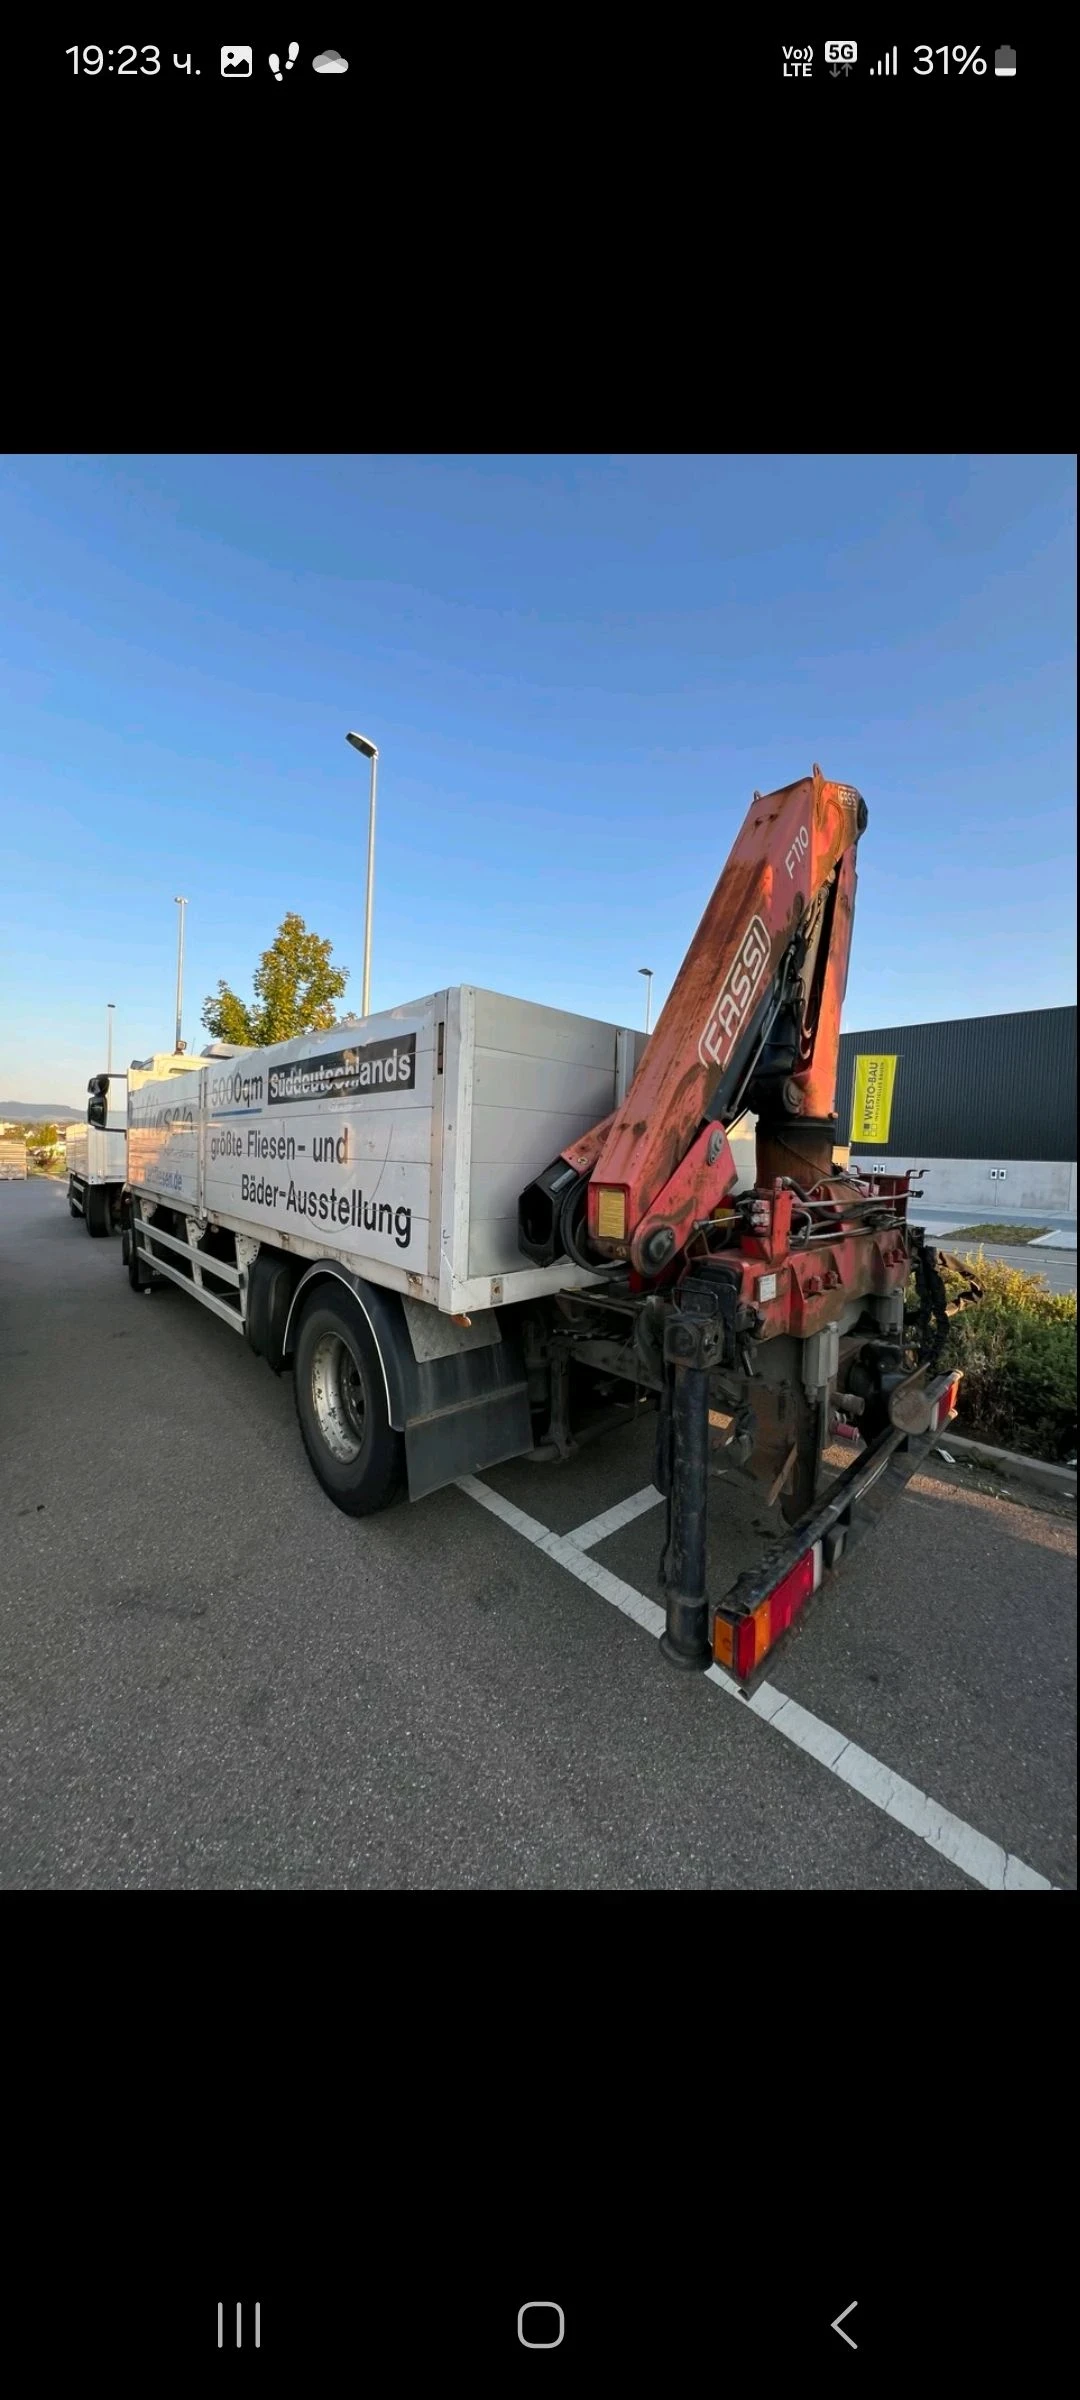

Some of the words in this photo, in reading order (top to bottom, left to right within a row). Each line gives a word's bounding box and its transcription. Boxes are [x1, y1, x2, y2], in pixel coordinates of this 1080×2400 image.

[785, 825, 809, 880] F110
[704, 927, 766, 1066] FASSI
[211, 1072, 263, 1108] 5000qm
[864, 1062, 879, 1120] WESTO-BAU
[211, 1130, 243, 1161] größte
[312, 1127, 349, 1165] und
[241, 1173, 412, 1249] Bäder-Ausstellung
